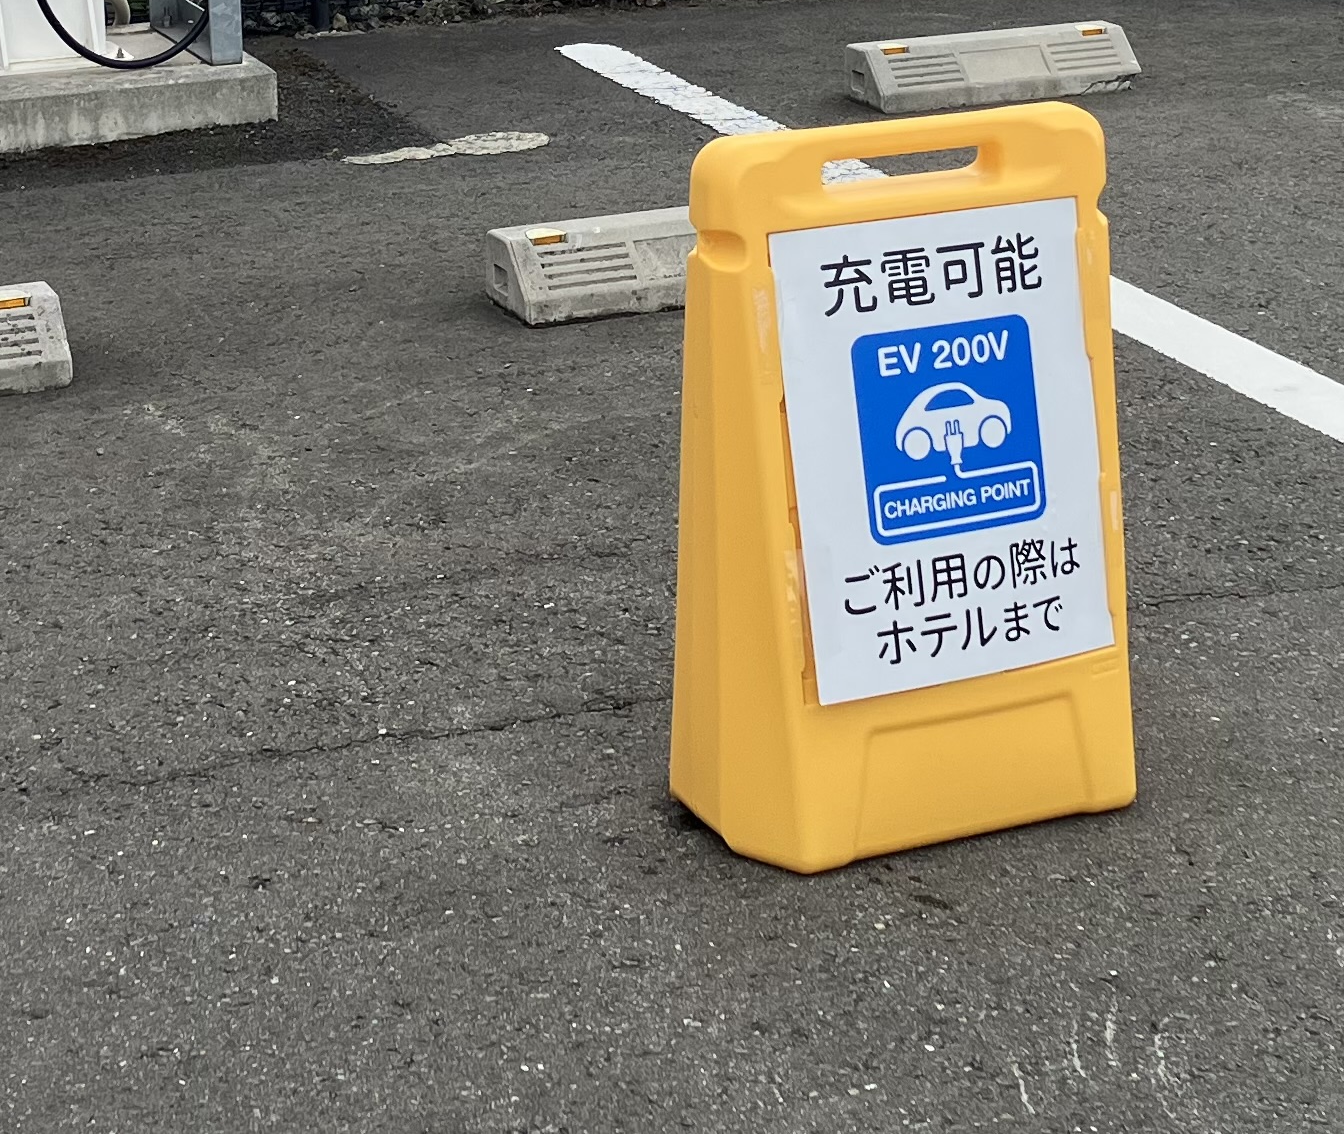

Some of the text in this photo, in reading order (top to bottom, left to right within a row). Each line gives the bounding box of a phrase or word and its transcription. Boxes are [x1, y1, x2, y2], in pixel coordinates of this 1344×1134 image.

[820, 232, 1044, 319] 充電可能
[878, 330, 1010, 378] EV 200V
[883, 477, 1032, 522] CHARGING POINT
[843, 538, 1081, 617] ご利用の際は
[877, 595, 1065, 666] ホテルまで
